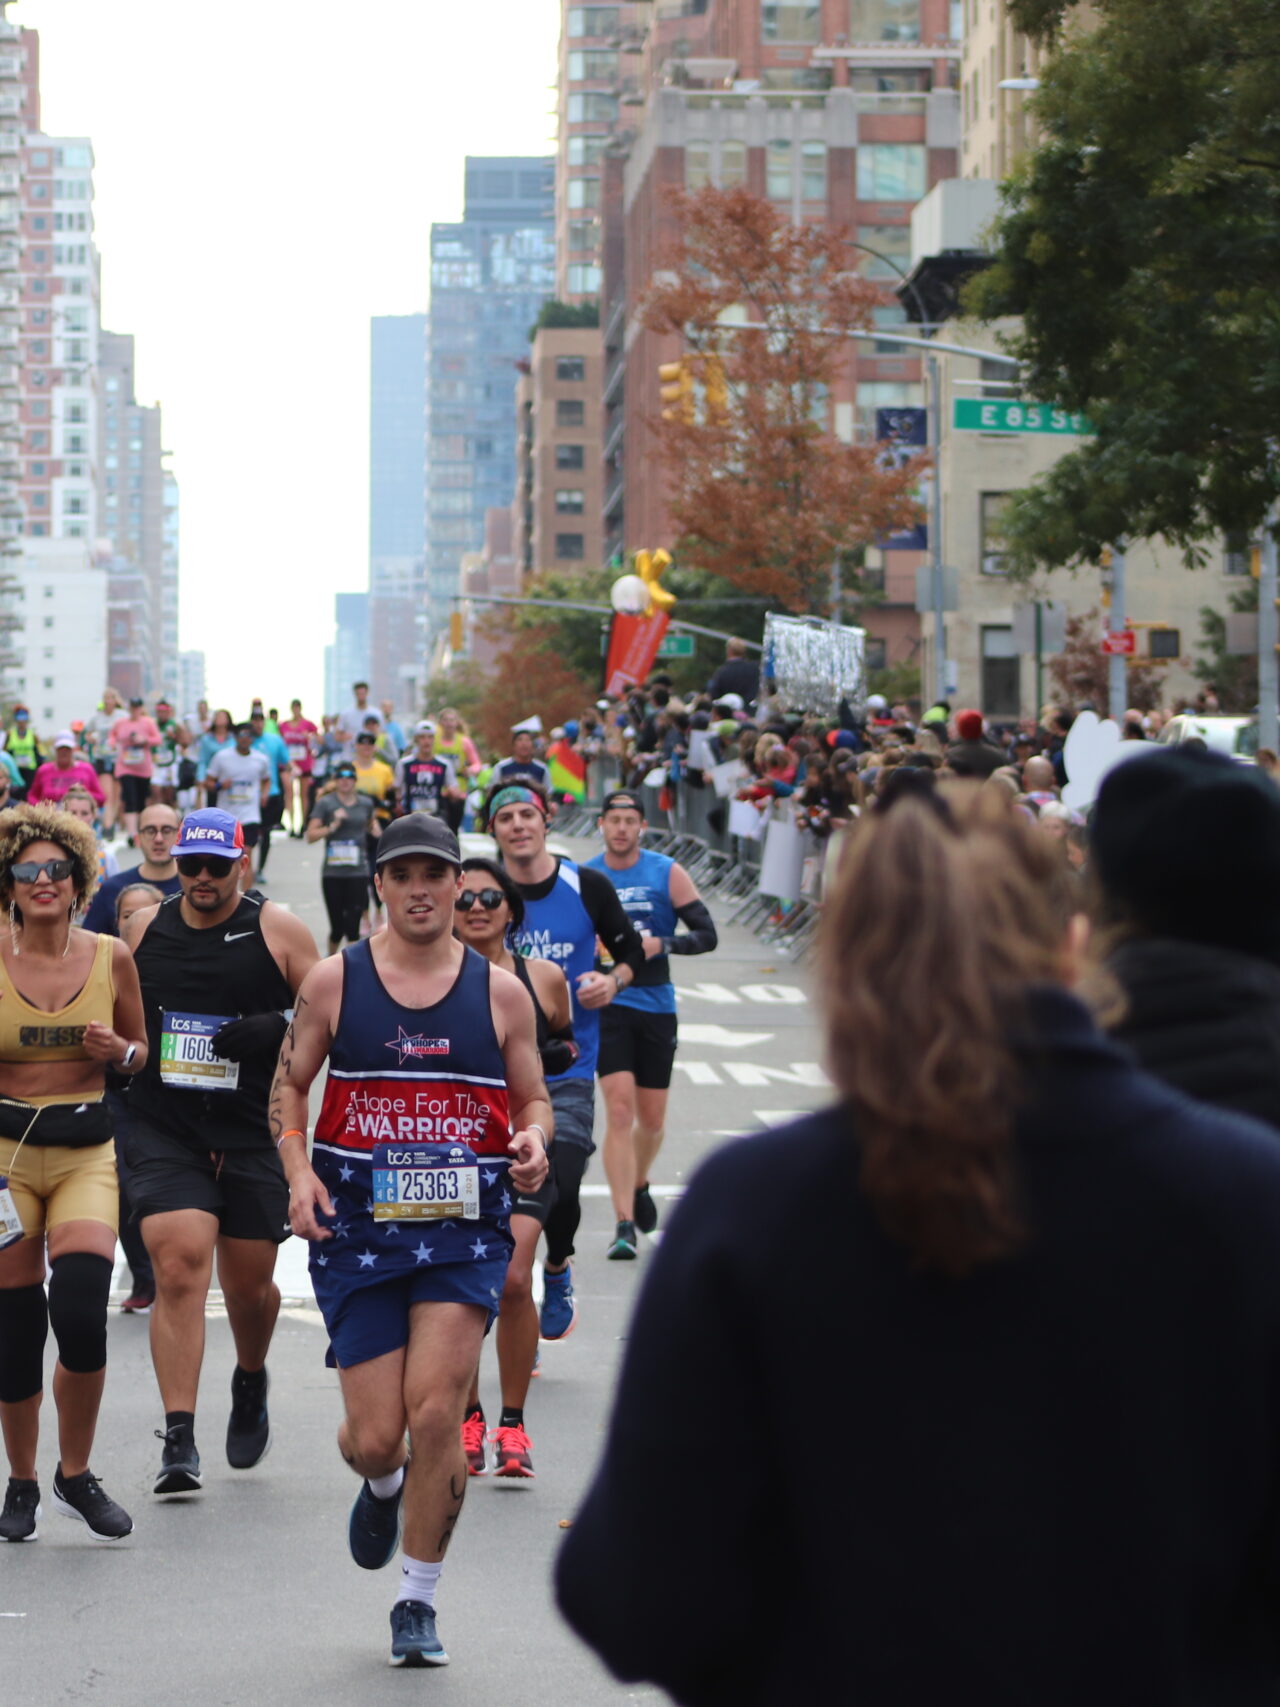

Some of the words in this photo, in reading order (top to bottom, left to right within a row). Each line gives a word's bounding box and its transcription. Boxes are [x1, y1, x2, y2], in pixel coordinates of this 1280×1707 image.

[981, 405, 998, 426] E
[1006, 406, 1041, 428] 85
[527, 942, 575, 959] AFSP
[182, 1037, 220, 1063] 1609
[353, 1090, 406, 1121] Hope
[415, 1093, 450, 1115] For
[455, 1093, 491, 1118] The
[357, 1112, 488, 1142] WARRIORS
[387, 1149, 412, 1165] tcs
[386, 1171, 394, 1184] 4
[402, 1170, 459, 1201] 25363
